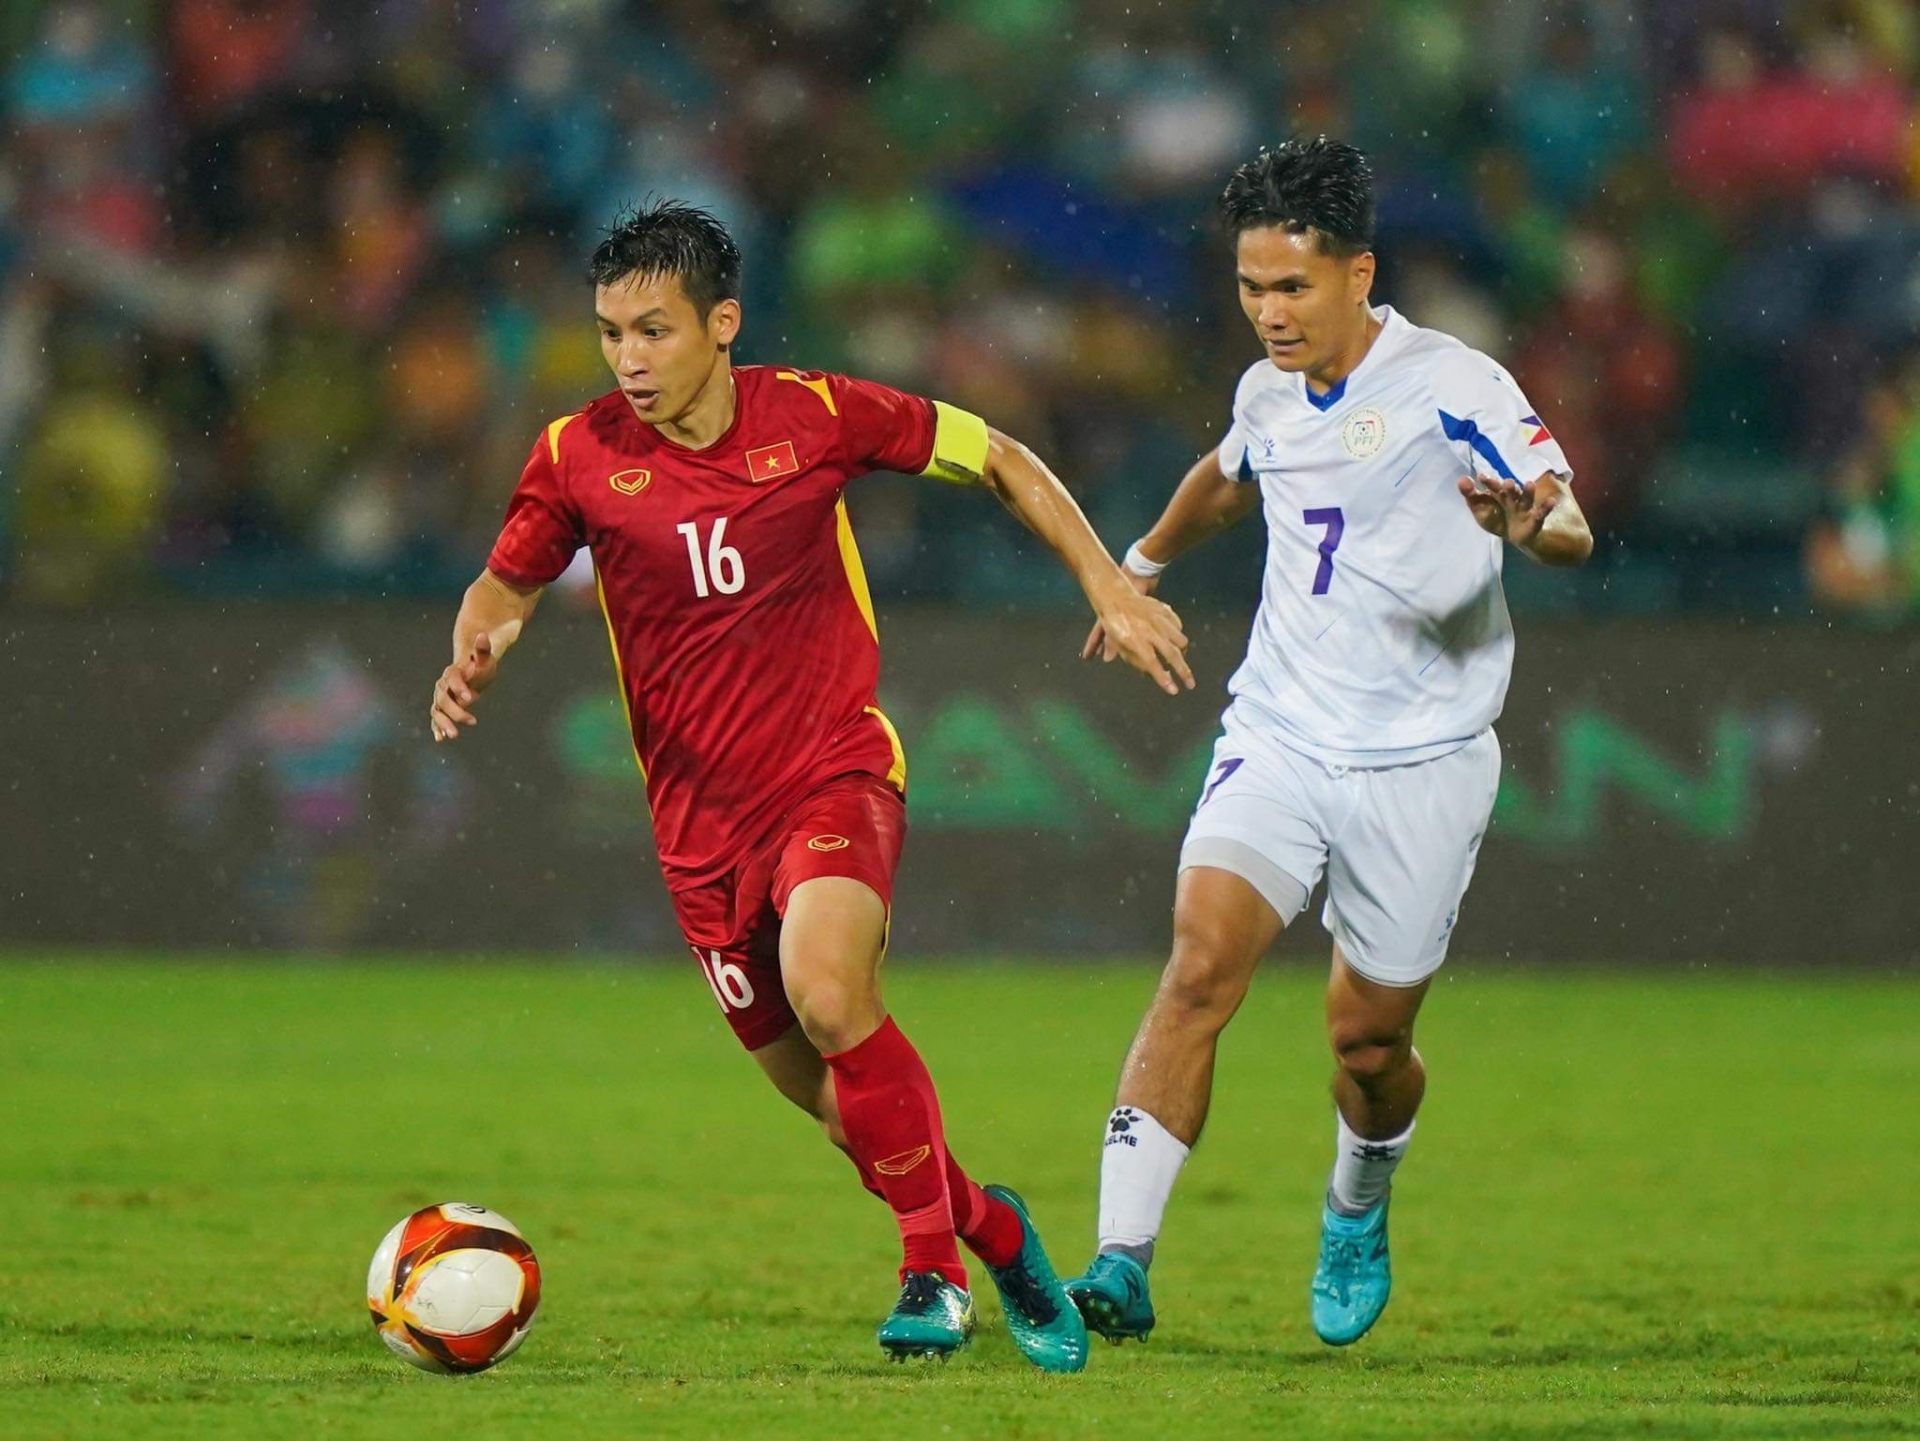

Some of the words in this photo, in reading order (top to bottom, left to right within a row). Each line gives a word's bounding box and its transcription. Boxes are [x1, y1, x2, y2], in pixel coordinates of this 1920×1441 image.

[677, 517, 745, 597] 16
[1303, 507, 1345, 595] 7
[1199, 758, 1245, 809] 7
